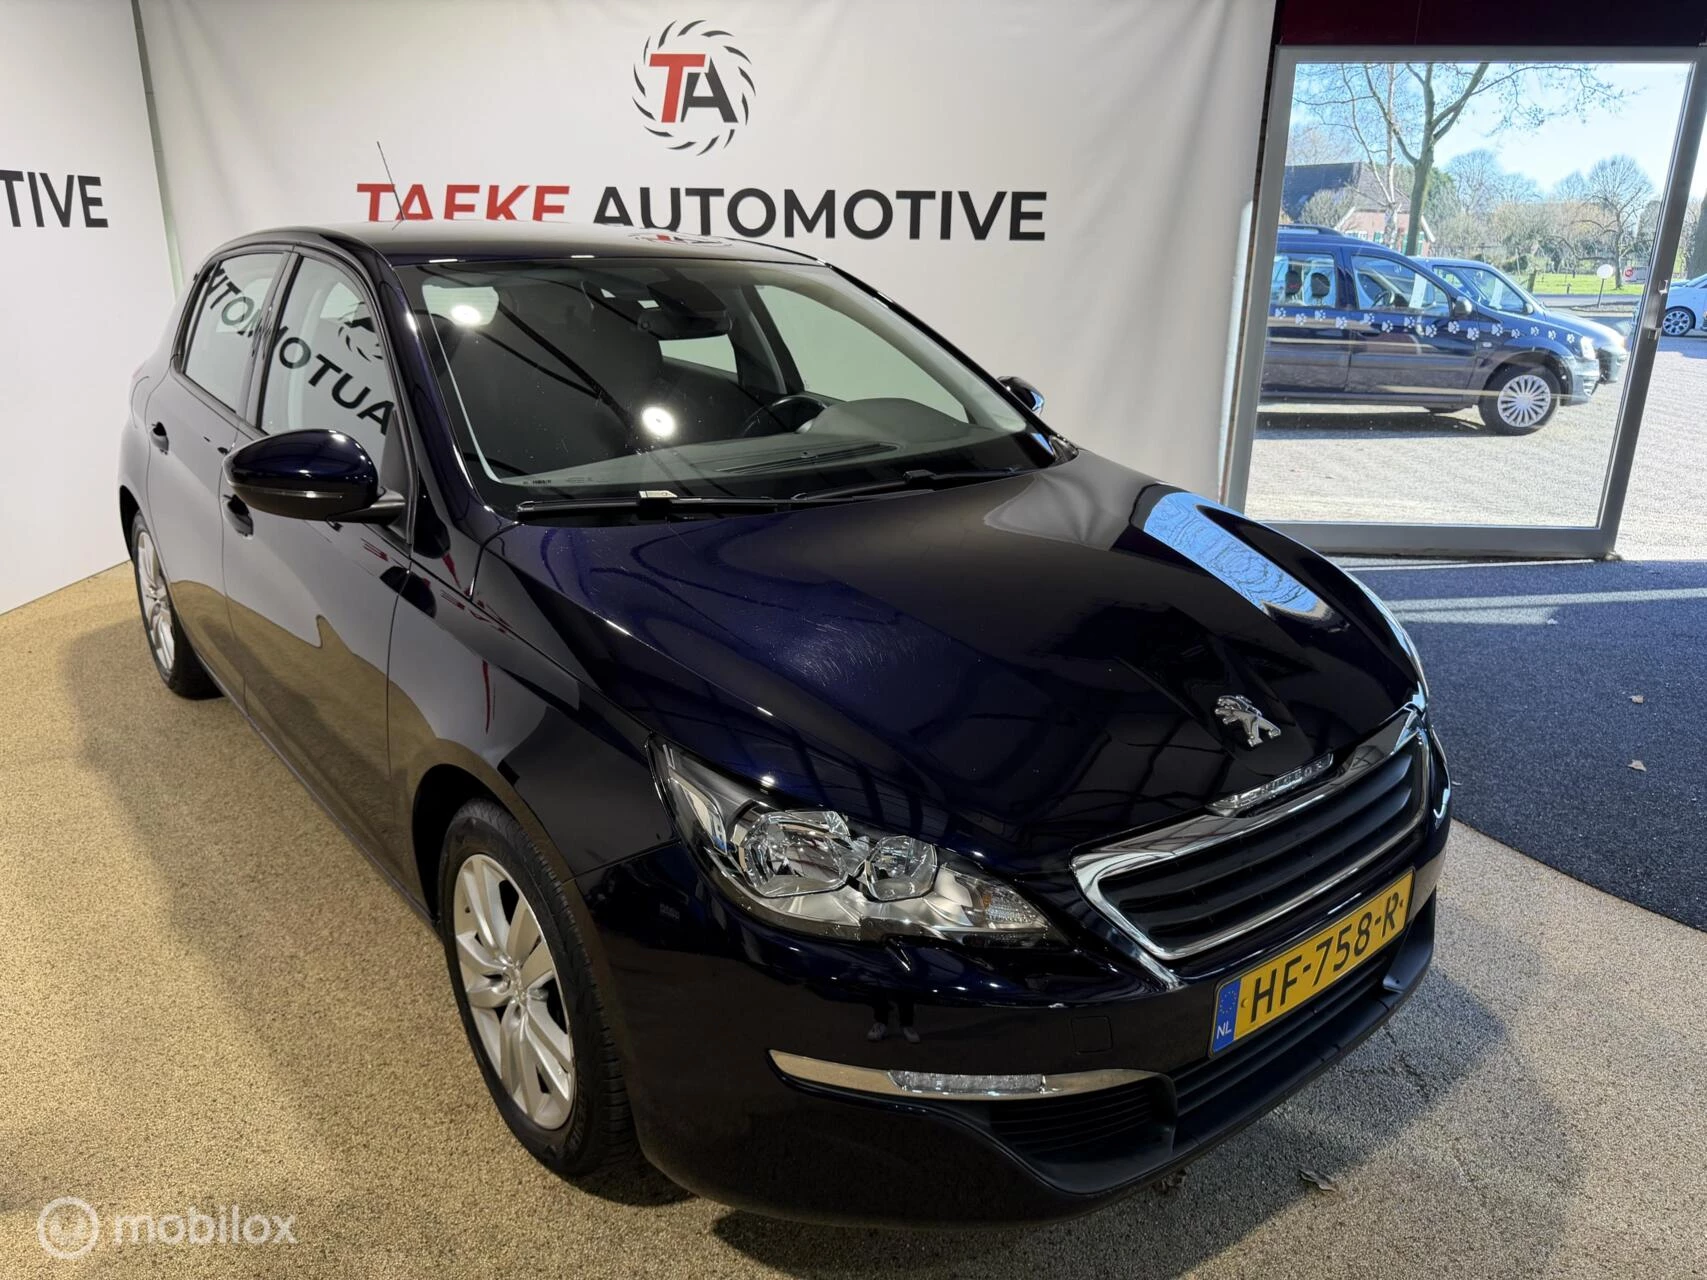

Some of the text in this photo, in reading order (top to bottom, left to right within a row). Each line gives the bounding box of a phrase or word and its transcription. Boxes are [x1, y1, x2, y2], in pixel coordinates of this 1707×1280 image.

[649, 53, 738, 123] TA
[593, 186, 1047, 241] AUTOMOTIVE
[1250, 891, 1400, 1024] HF-758-R
[1216, 1022, 1232, 1039] NL
